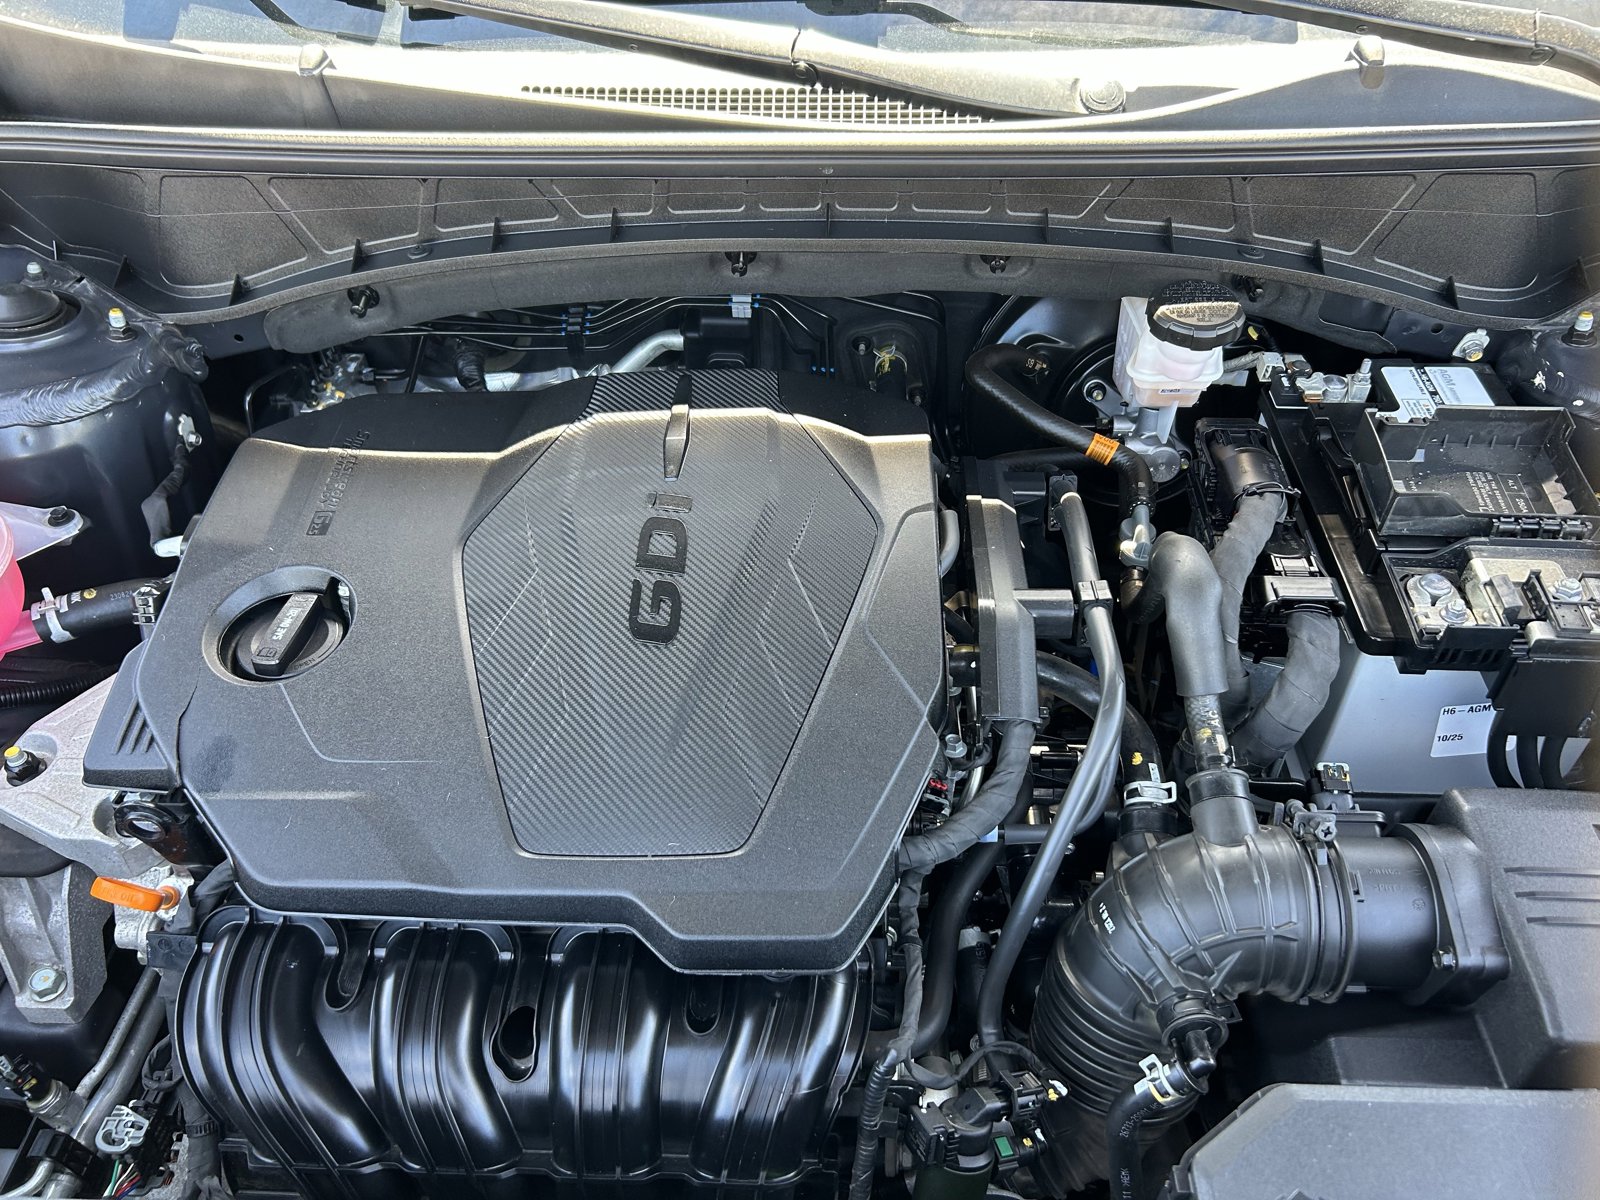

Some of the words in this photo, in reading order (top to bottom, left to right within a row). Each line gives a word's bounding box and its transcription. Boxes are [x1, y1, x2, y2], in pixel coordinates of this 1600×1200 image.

[279, 608, 301, 628] 0W-20
[272, 627, 288, 641] SAE
[1442, 707, 1456, 716] H6
[1467, 704, 1491, 714] AGM
[1436, 733, 1463, 742] 10/25
